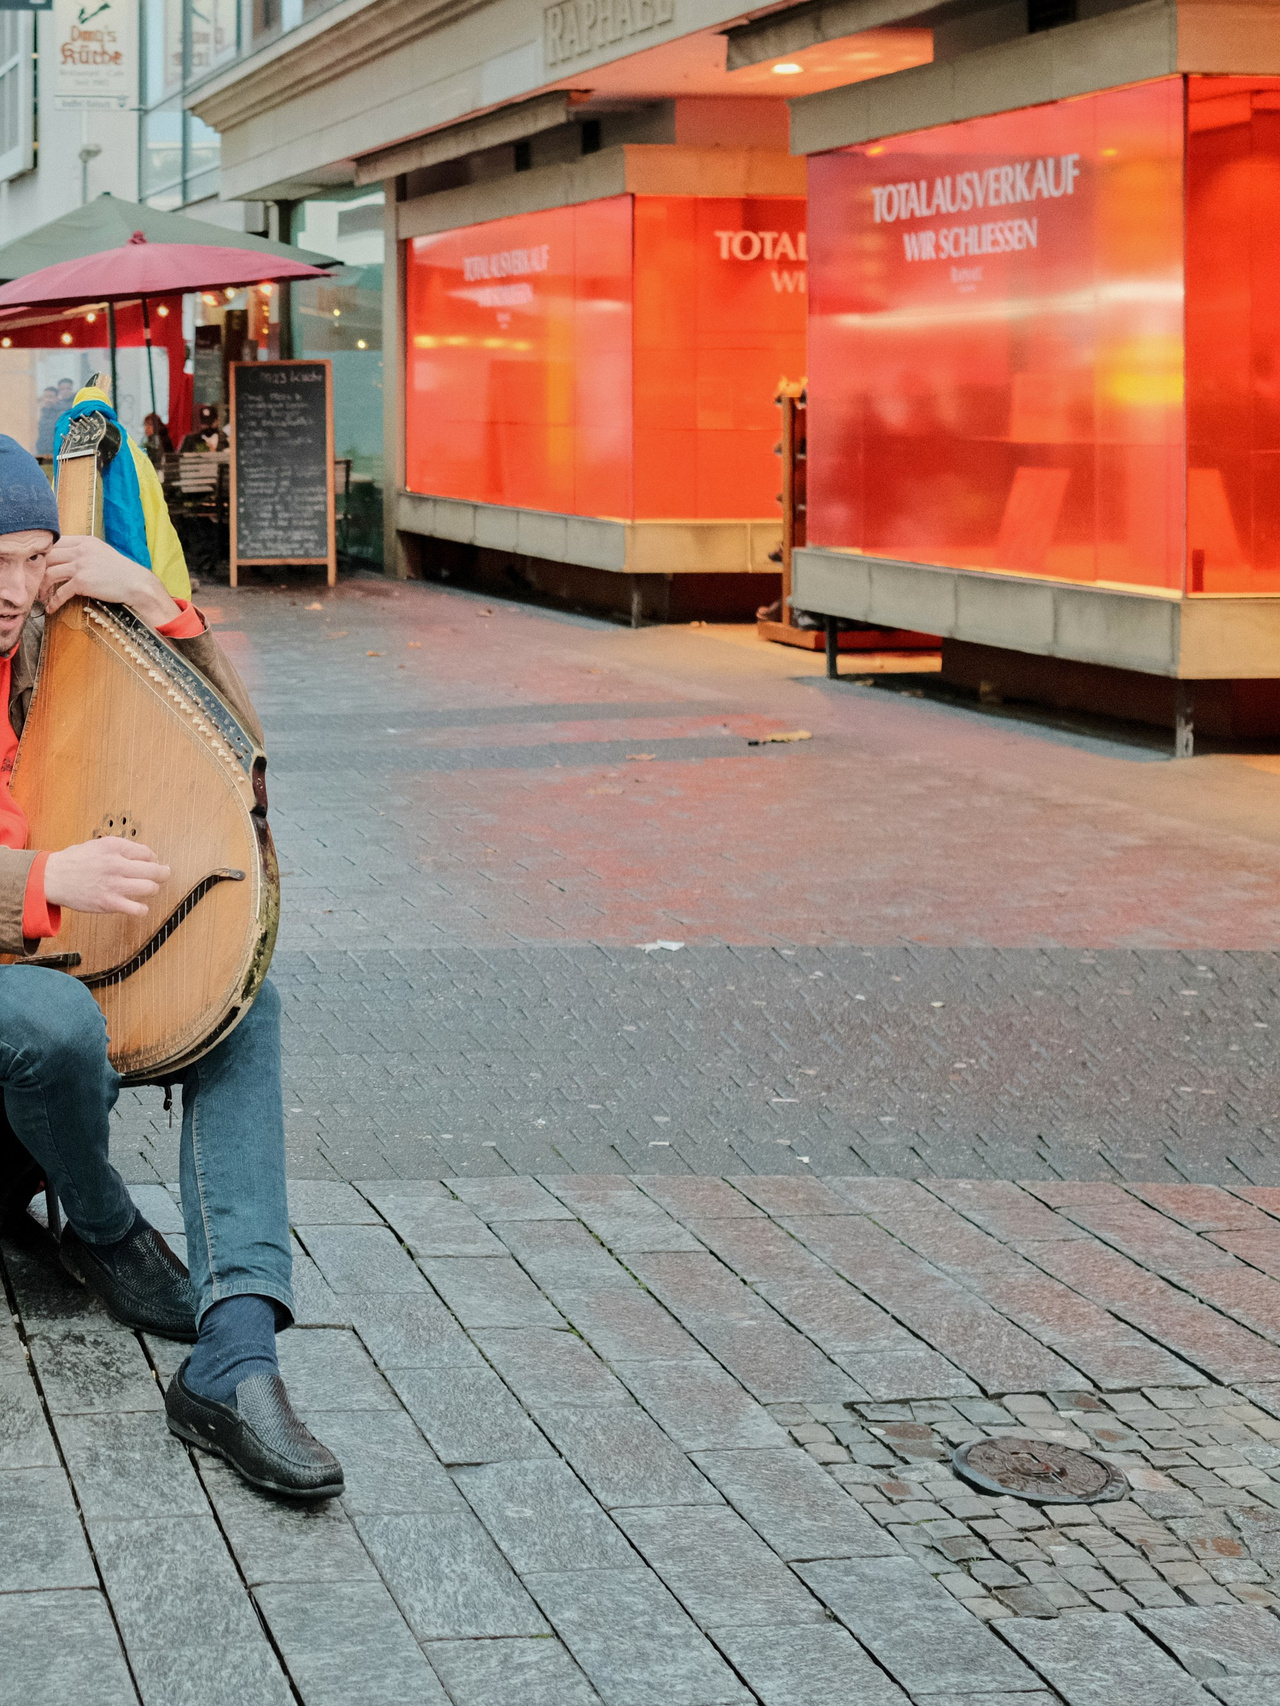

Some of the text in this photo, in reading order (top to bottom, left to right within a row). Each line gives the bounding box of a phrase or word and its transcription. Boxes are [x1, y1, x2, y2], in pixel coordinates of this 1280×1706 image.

[870, 152, 1081, 223] TOTALAUSVERKAUF
[902, 216, 1038, 262] WIR SCHLIESSEN
[770, 270, 807, 294] WI
